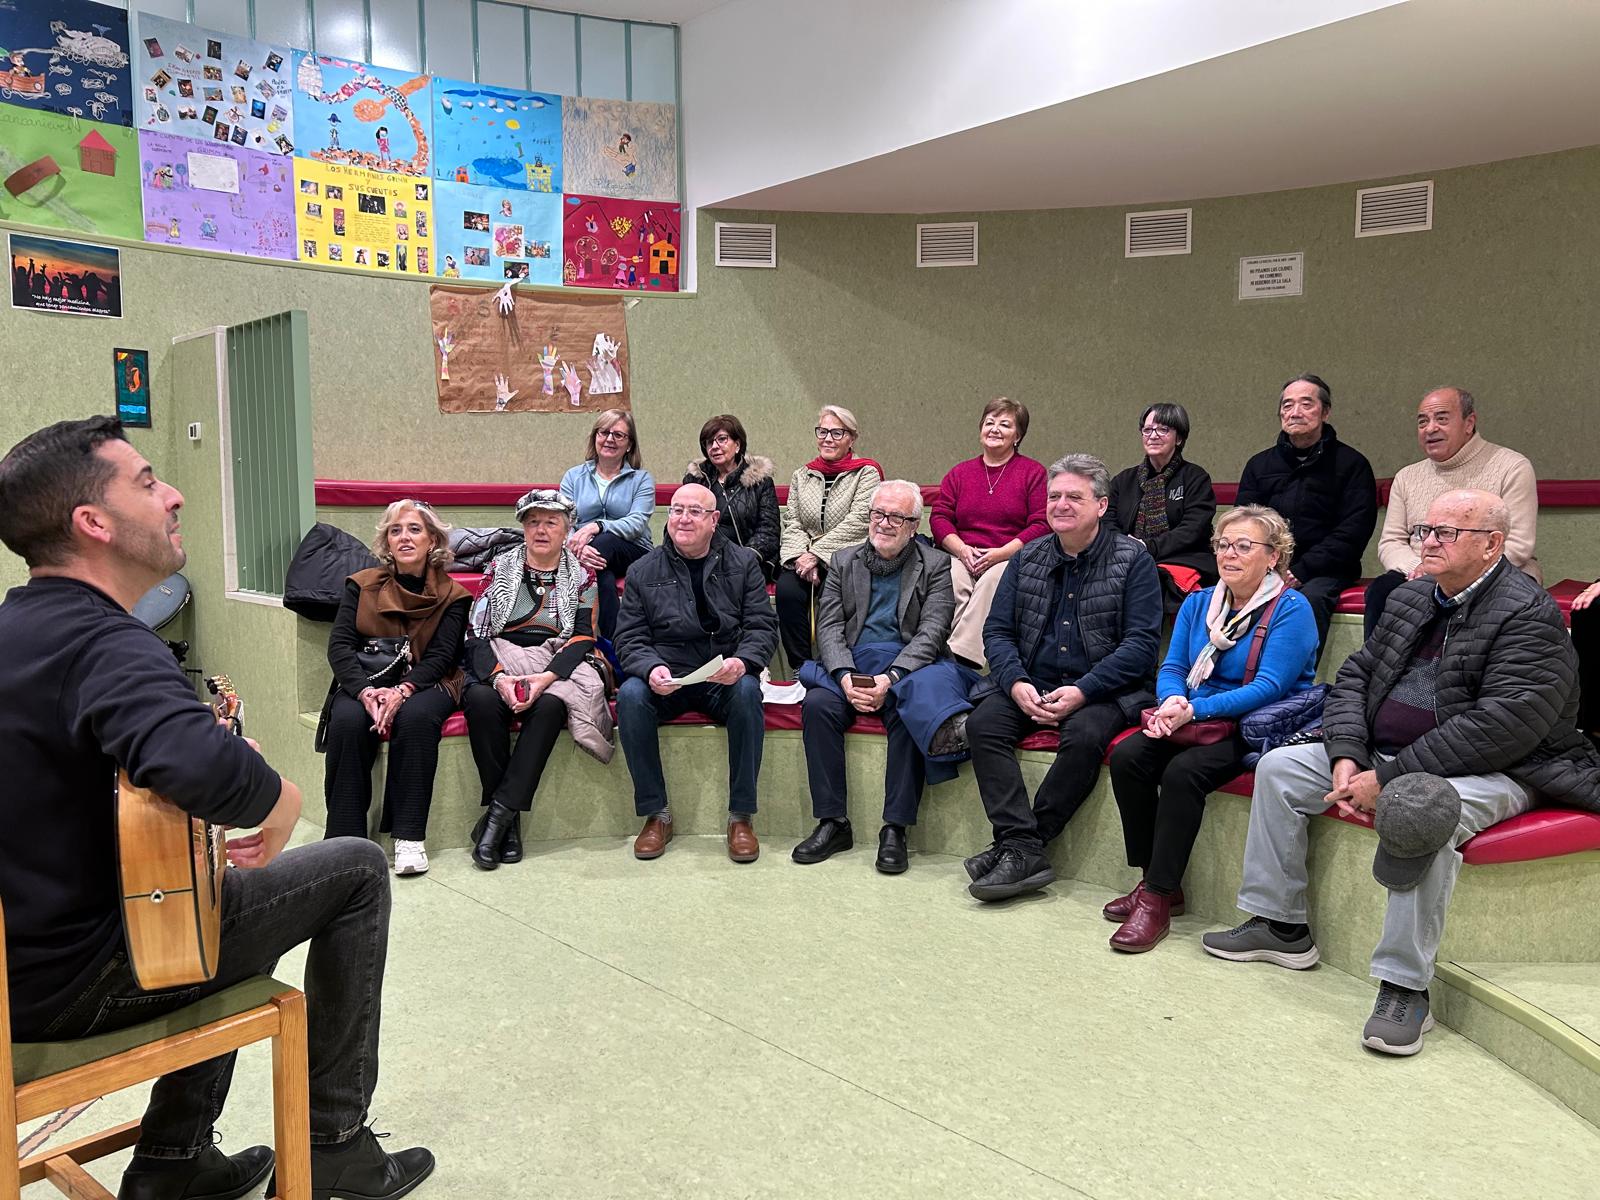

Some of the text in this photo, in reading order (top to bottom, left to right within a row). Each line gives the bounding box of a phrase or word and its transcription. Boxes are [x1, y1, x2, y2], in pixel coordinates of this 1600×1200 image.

[326, 164, 341, 173] LOS
[343, 166, 385, 180] HERMANOS
[348, 183, 398, 197] SUS CUENTOS
[42, 295, 52, 303] hay
